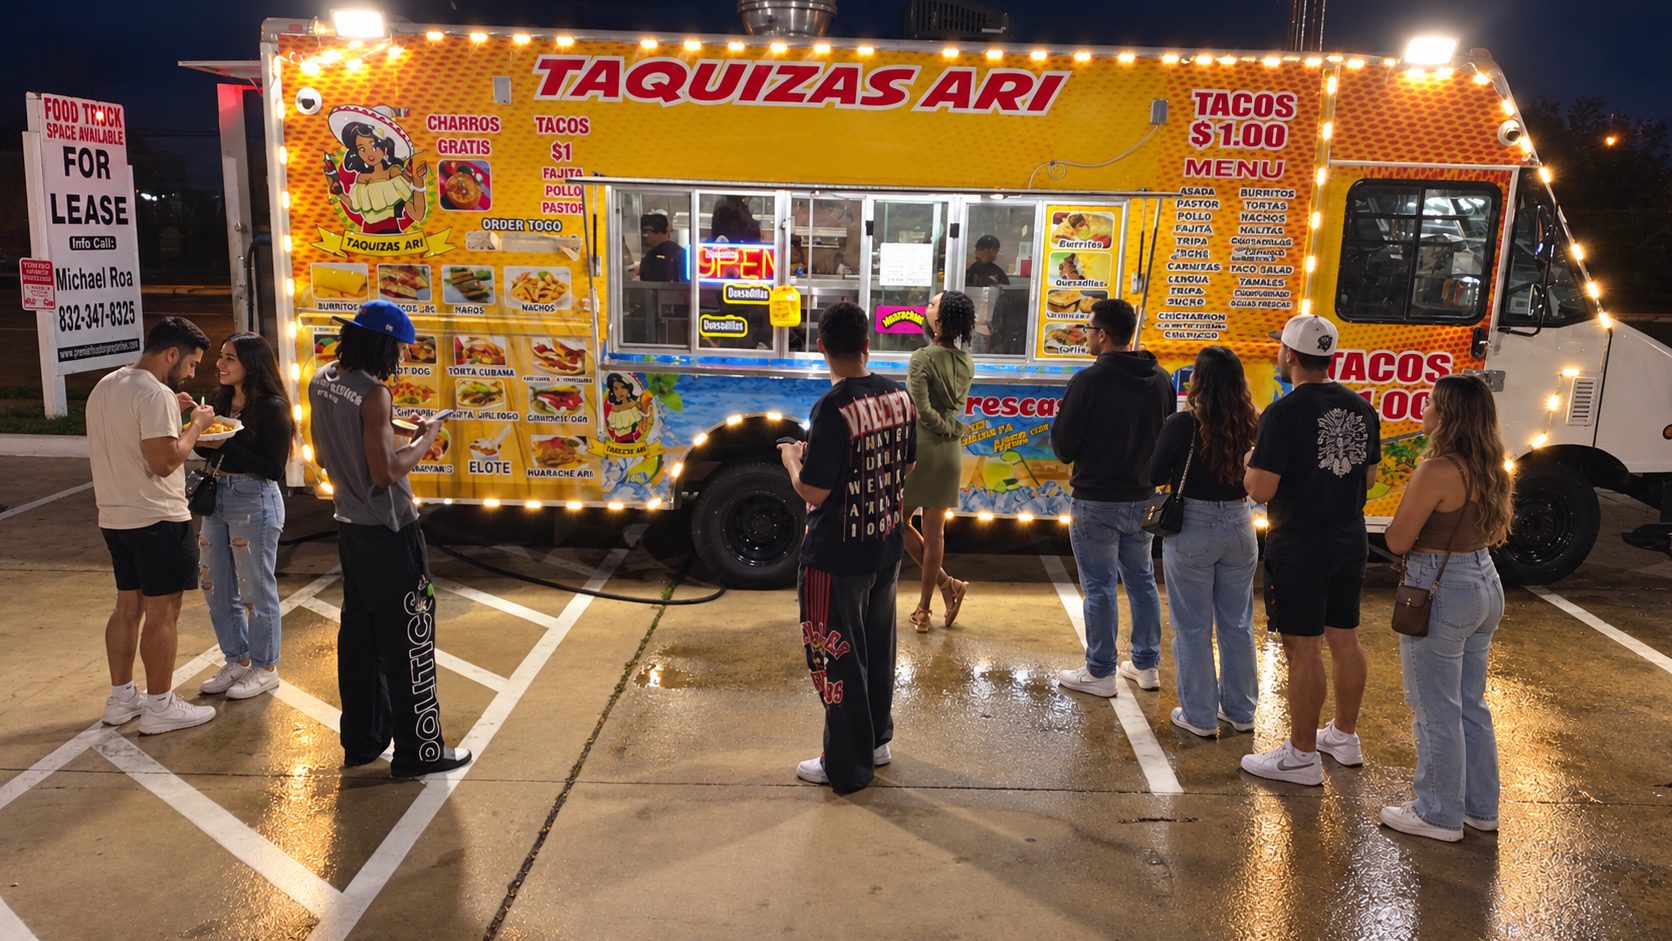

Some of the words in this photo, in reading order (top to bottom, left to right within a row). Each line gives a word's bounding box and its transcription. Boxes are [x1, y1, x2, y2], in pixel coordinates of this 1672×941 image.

[534, 55, 920, 109] TAQUIZAS
[913, 65, 1070, 115] ARI
[44, 97, 79, 124] FOOD
[81, 102, 123, 128] TRUCK
[1194, 91, 1296, 119] TACOS
[427, 115, 500, 132] CHARROS
[535, 116, 590, 134] TACOS
[46, 122, 76, 141] SPACE
[79, 127, 124, 145] AVAILABLE
[1190, 120, 1287, 148] $1.00
[437, 139, 491, 155] GRATIS
[551, 141, 571, 161] $1
[62, 146, 111, 180] FOR
[1185, 158, 1285, 179] MENU
[542, 167, 584, 178] FAJITA
[545, 185, 582, 197] POLLO
[1240, 188, 1294, 197] BURRITOS
[50, 193, 129, 226] LEASE
[1177, 200, 1219, 208] PASTOR
[482, 217, 524, 231] ORDER
[528, 219, 562, 232] TOGO
[1178, 212, 1211, 221] POLLO
[1241, 213, 1286, 222] NACHOS
[72, 237, 91, 249] Info
[93, 238, 114, 249] Call:
[346, 237, 400, 251] TAQUIZAS
[404, 238, 424, 250] ARI
[1176, 237, 1208, 245] TRIPA
[55, 267, 106, 291] Michael
[109, 266, 134, 288] Roa
[521, 303, 556, 312] NACHOS
[58, 300, 136, 333] 832-347-8325
[411, 367, 431, 375] DOG
[1328, 351, 1453, 383] TACOS
[469, 461, 510, 474] ELOTE
